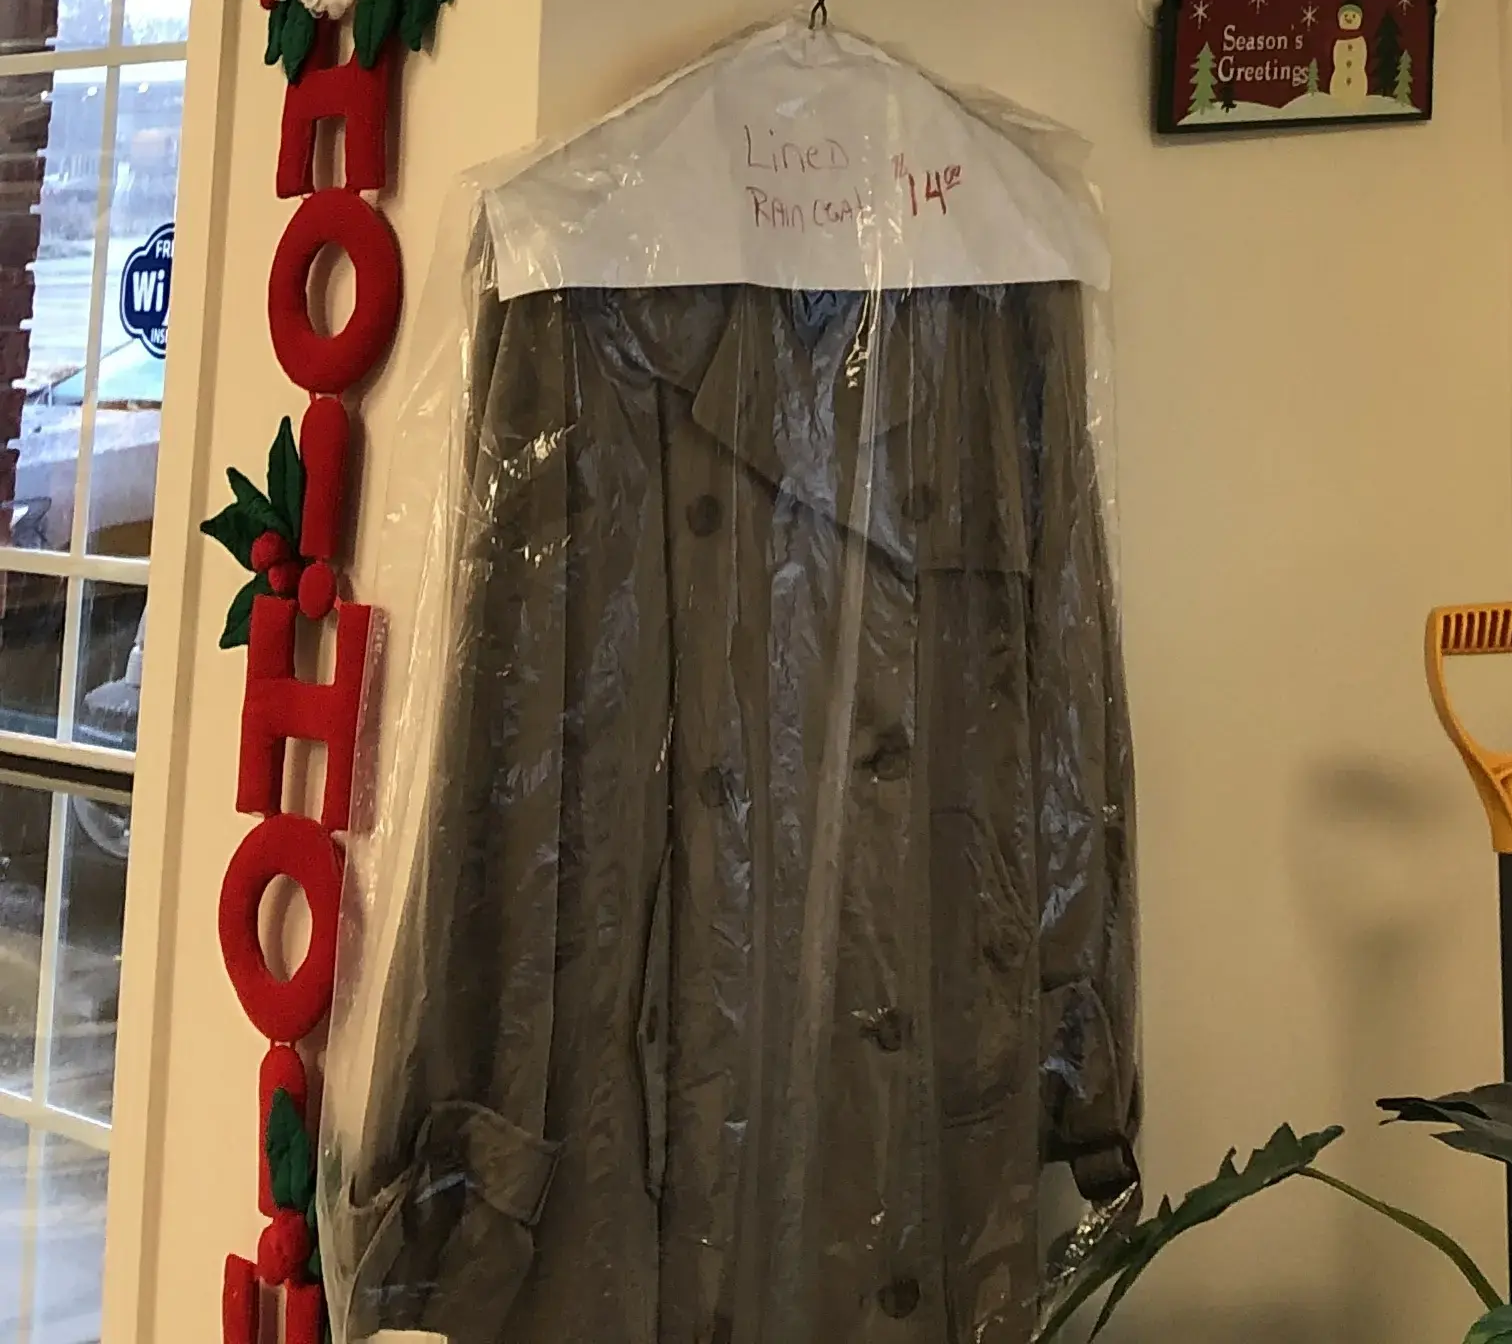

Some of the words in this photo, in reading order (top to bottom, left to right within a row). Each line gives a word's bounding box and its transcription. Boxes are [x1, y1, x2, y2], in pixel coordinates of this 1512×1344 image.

[1222, 24, 1303, 51] Season's
[1218, 55, 1309, 87] Greetings
[155, 238, 174, 259] FR
[132, 269, 166, 313] Wi
